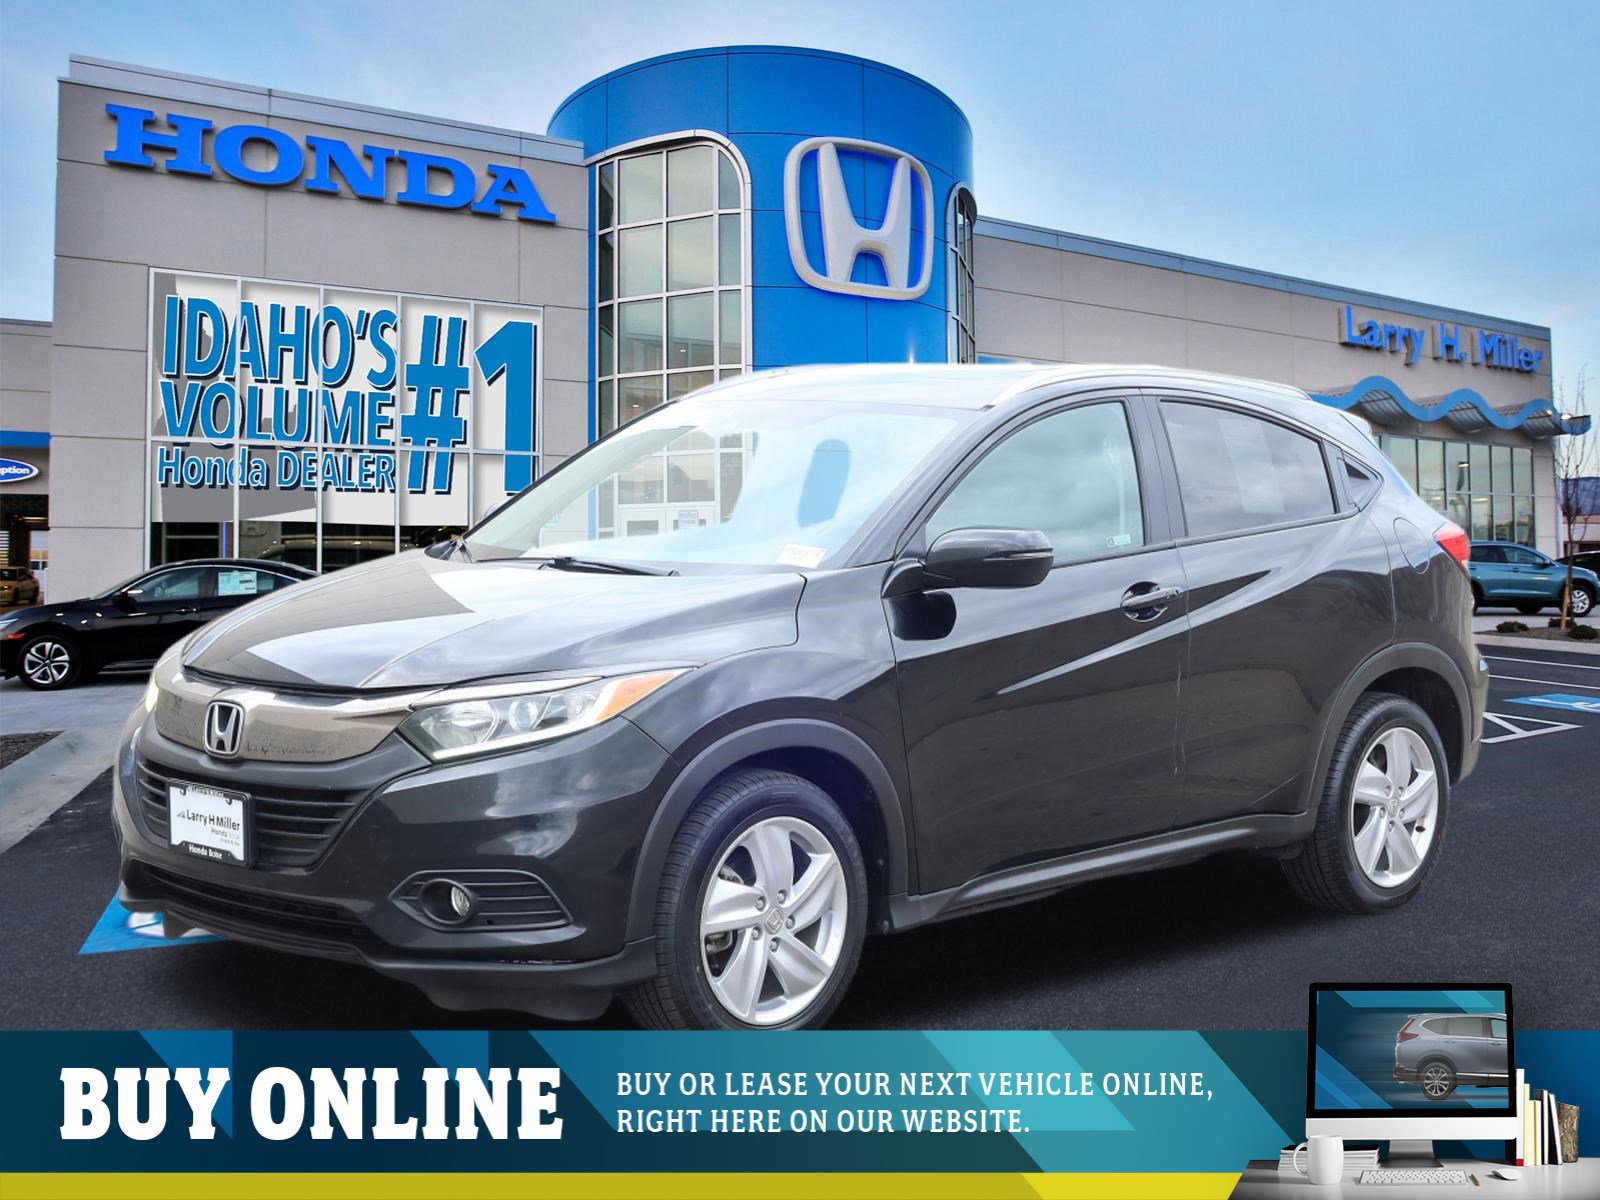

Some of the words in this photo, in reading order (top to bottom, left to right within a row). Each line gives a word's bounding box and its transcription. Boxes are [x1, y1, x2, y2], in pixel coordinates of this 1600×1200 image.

[105, 103, 557, 223] HONDA
[162, 294, 399, 390] IDAHO'S
[1343, 305, 1424, 366] Larry
[1437, 322, 1469, 362] H.
[1476, 330, 1545, 372] Miller
[160, 380, 397, 448] VOLUME
[400, 315, 538, 495] #1
[0, 466, 30, 476] ption
[157, 446, 267, 490] Honda
[276, 451, 397, 492] DEALER
[186, 809, 208, 827] Larry
[208, 814, 215, 825] H
[216, 815, 241, 831] Miller
[188, 843, 207, 856] Honda
